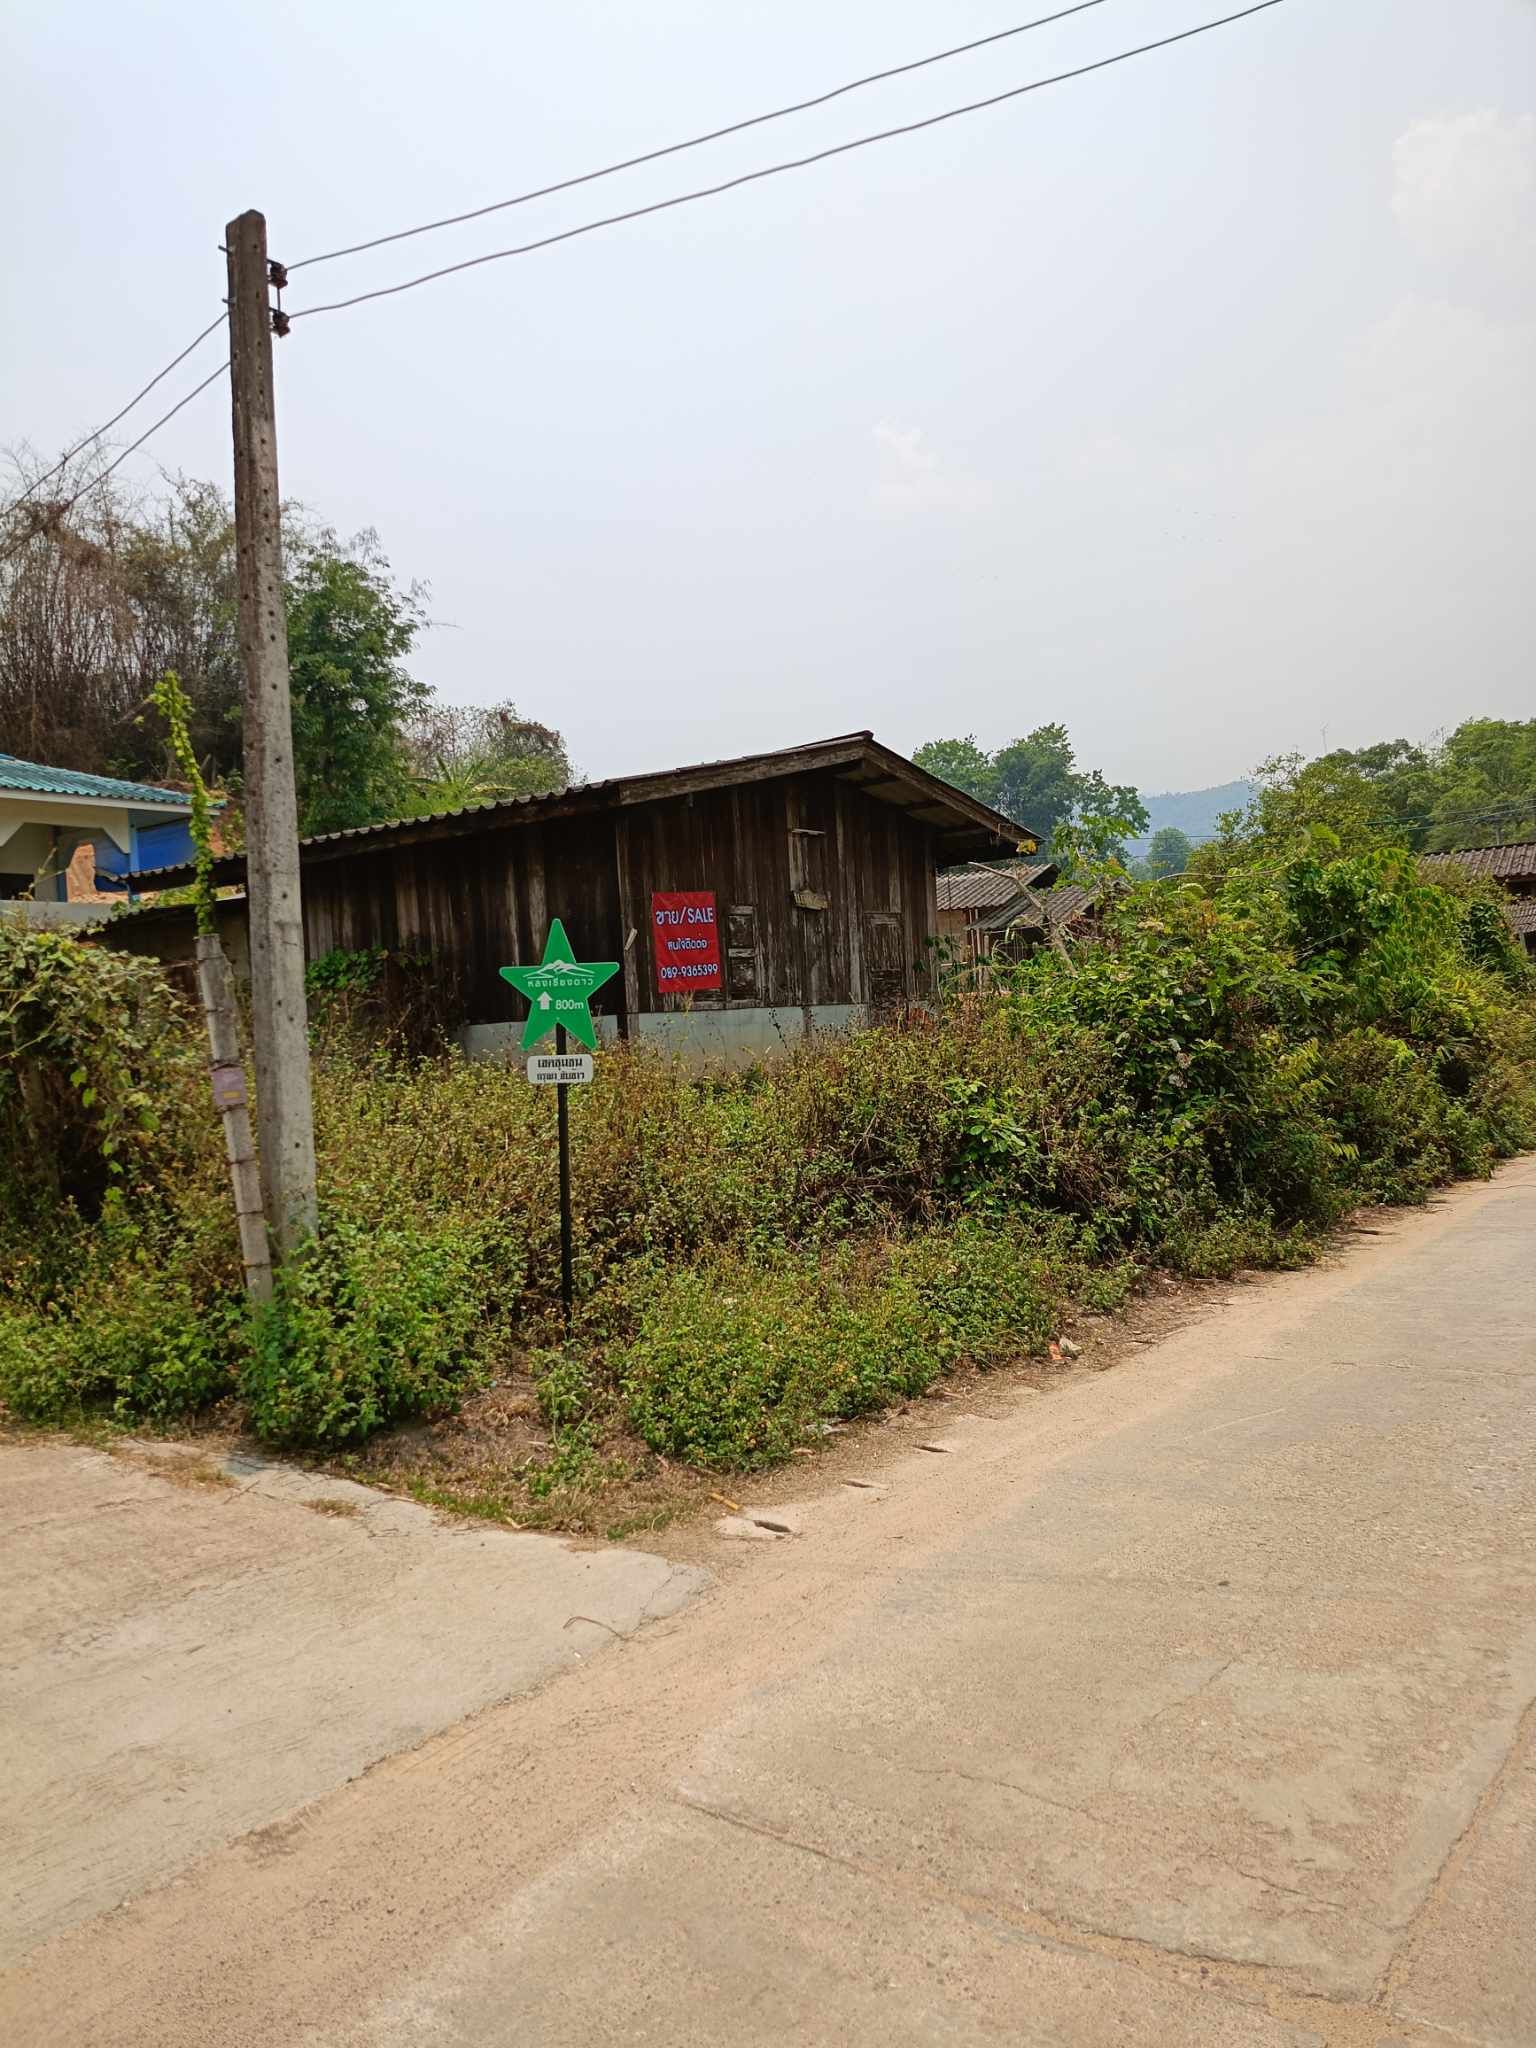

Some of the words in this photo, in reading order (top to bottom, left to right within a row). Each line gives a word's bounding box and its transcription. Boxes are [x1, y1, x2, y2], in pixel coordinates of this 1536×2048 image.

[655, 906, 714, 925] ขาย/SALE
[660, 963, 718, 979] 089-9365399
[555, 999, 584, 1010] 800m
